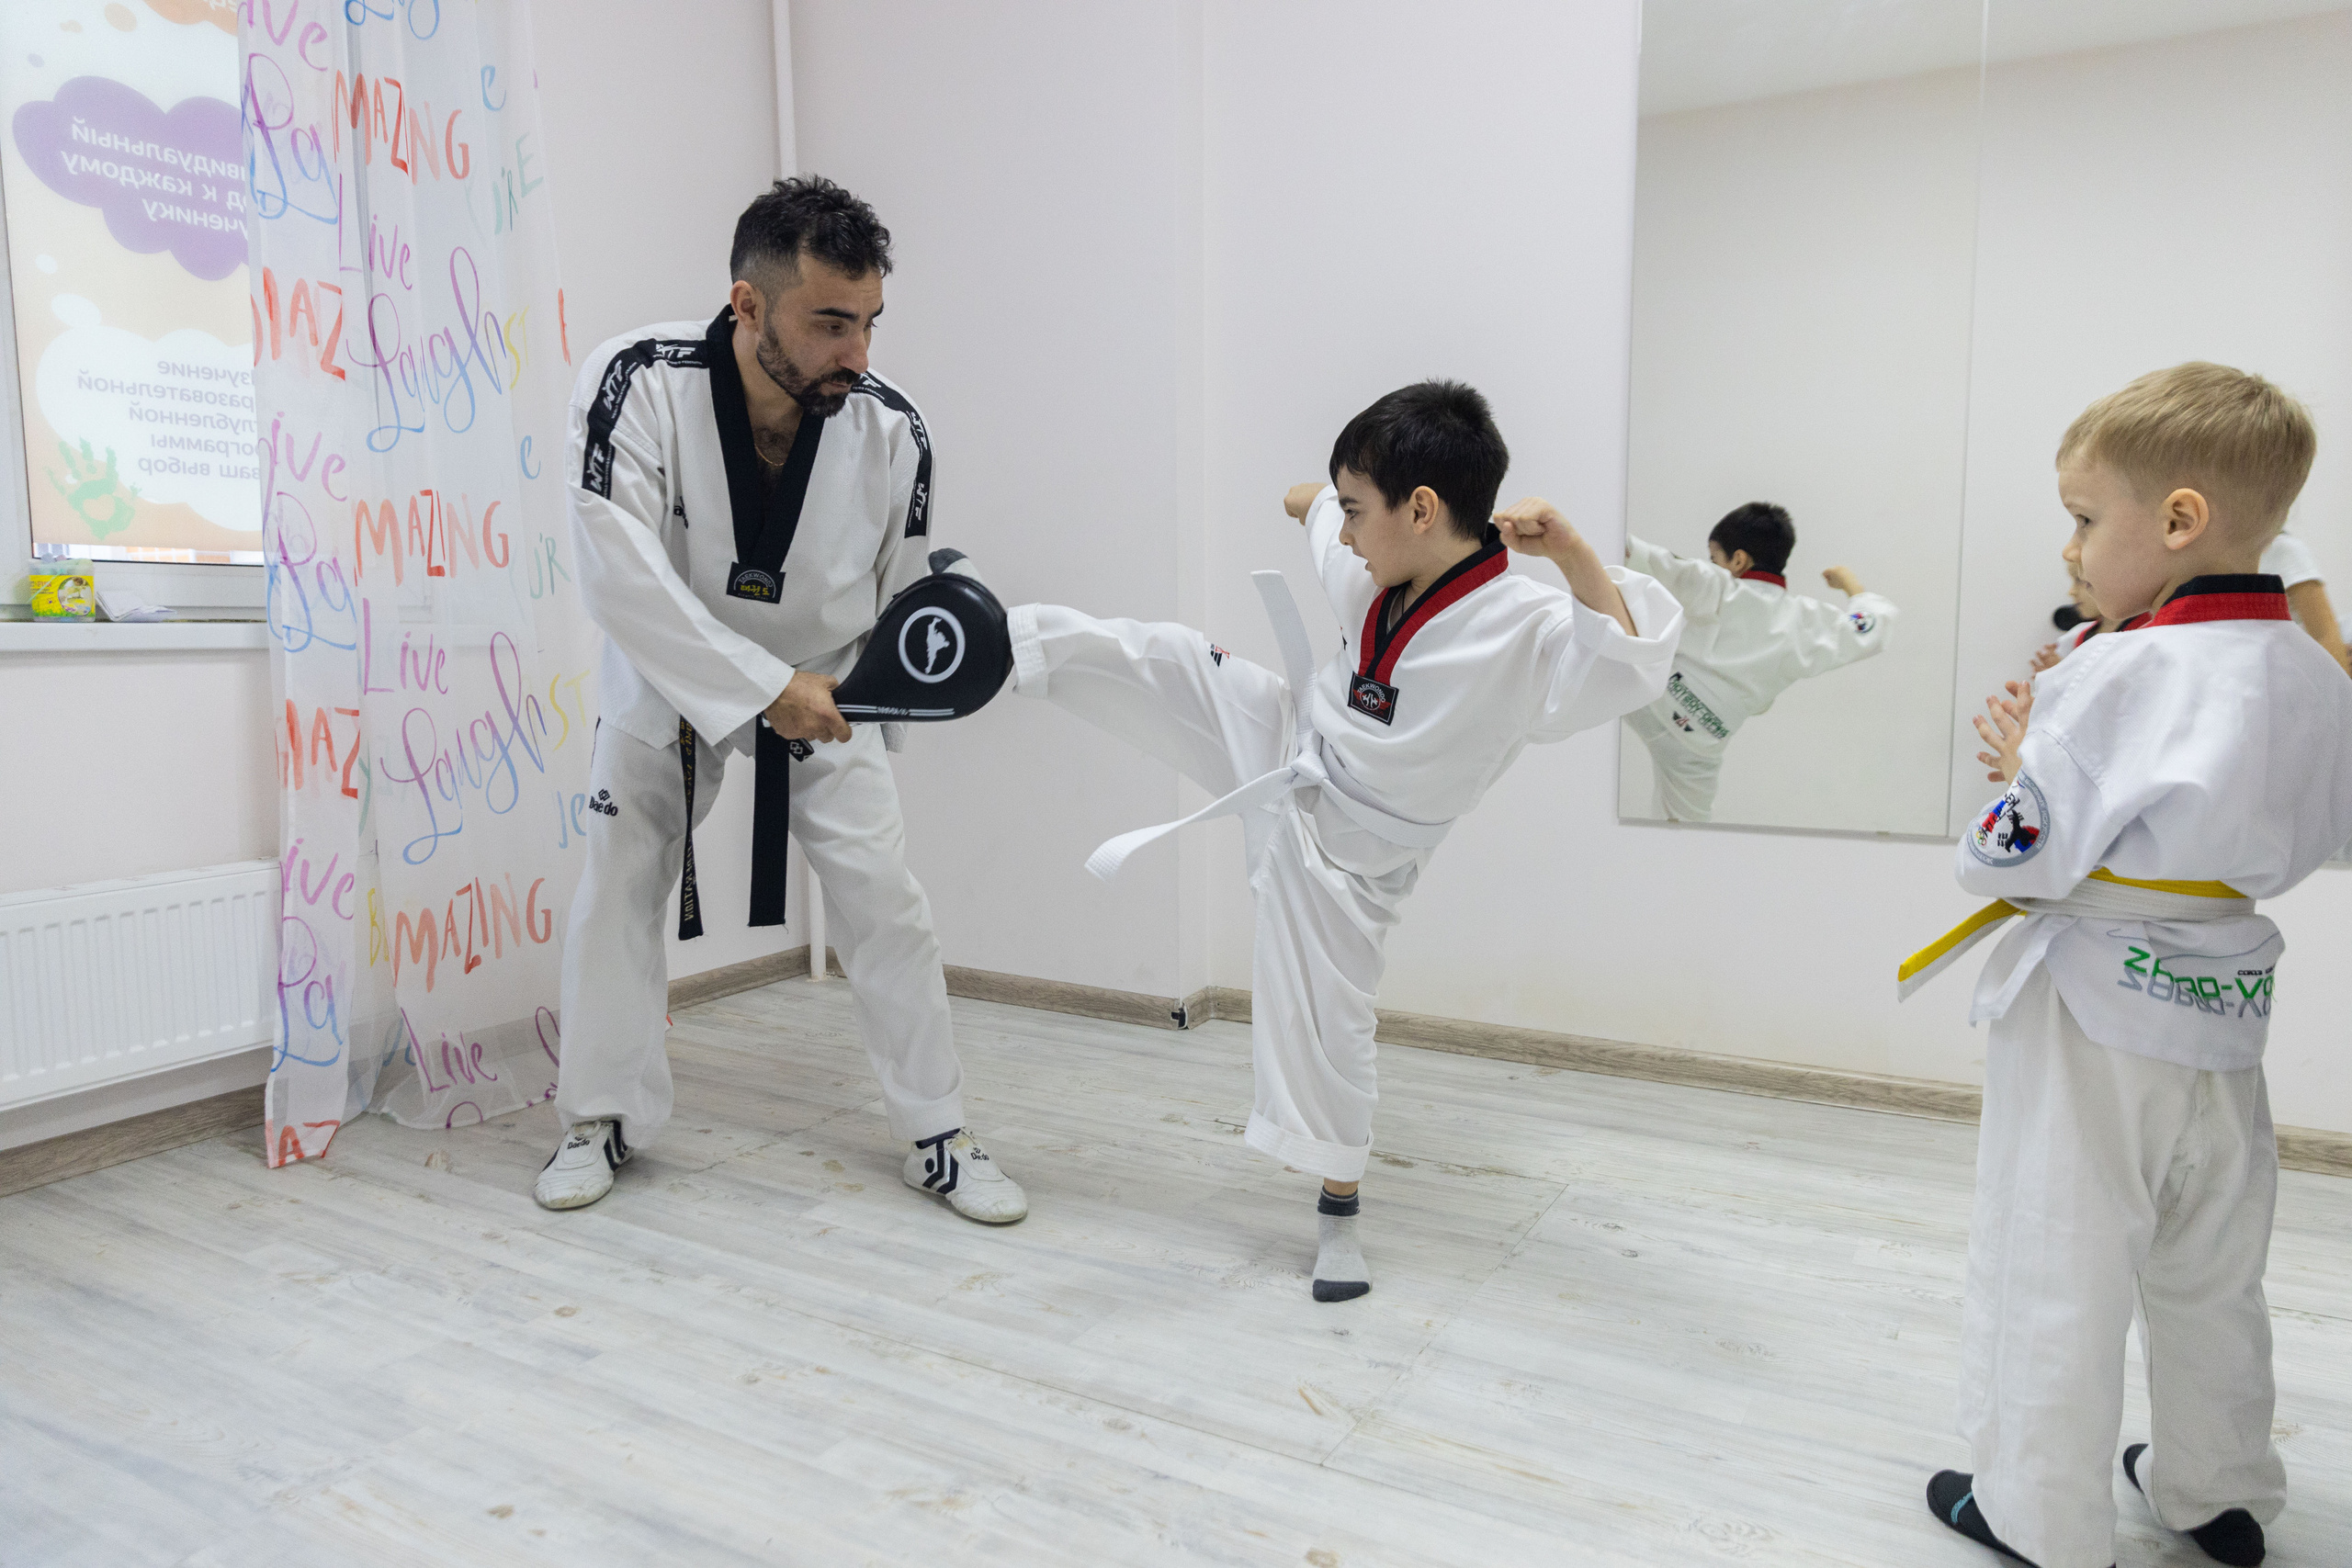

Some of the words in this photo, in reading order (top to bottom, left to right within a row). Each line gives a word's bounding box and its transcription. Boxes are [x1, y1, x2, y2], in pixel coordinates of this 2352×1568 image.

[338, 172, 413, 290] Live
[602, 359, 623, 411] WTF
[586, 443, 605, 492] WTF
[739, 572, 774, 589] TAEKWONDO
[363, 597, 448, 695] Live
[1357, 682, 1386, 704] TAEKWONDO
